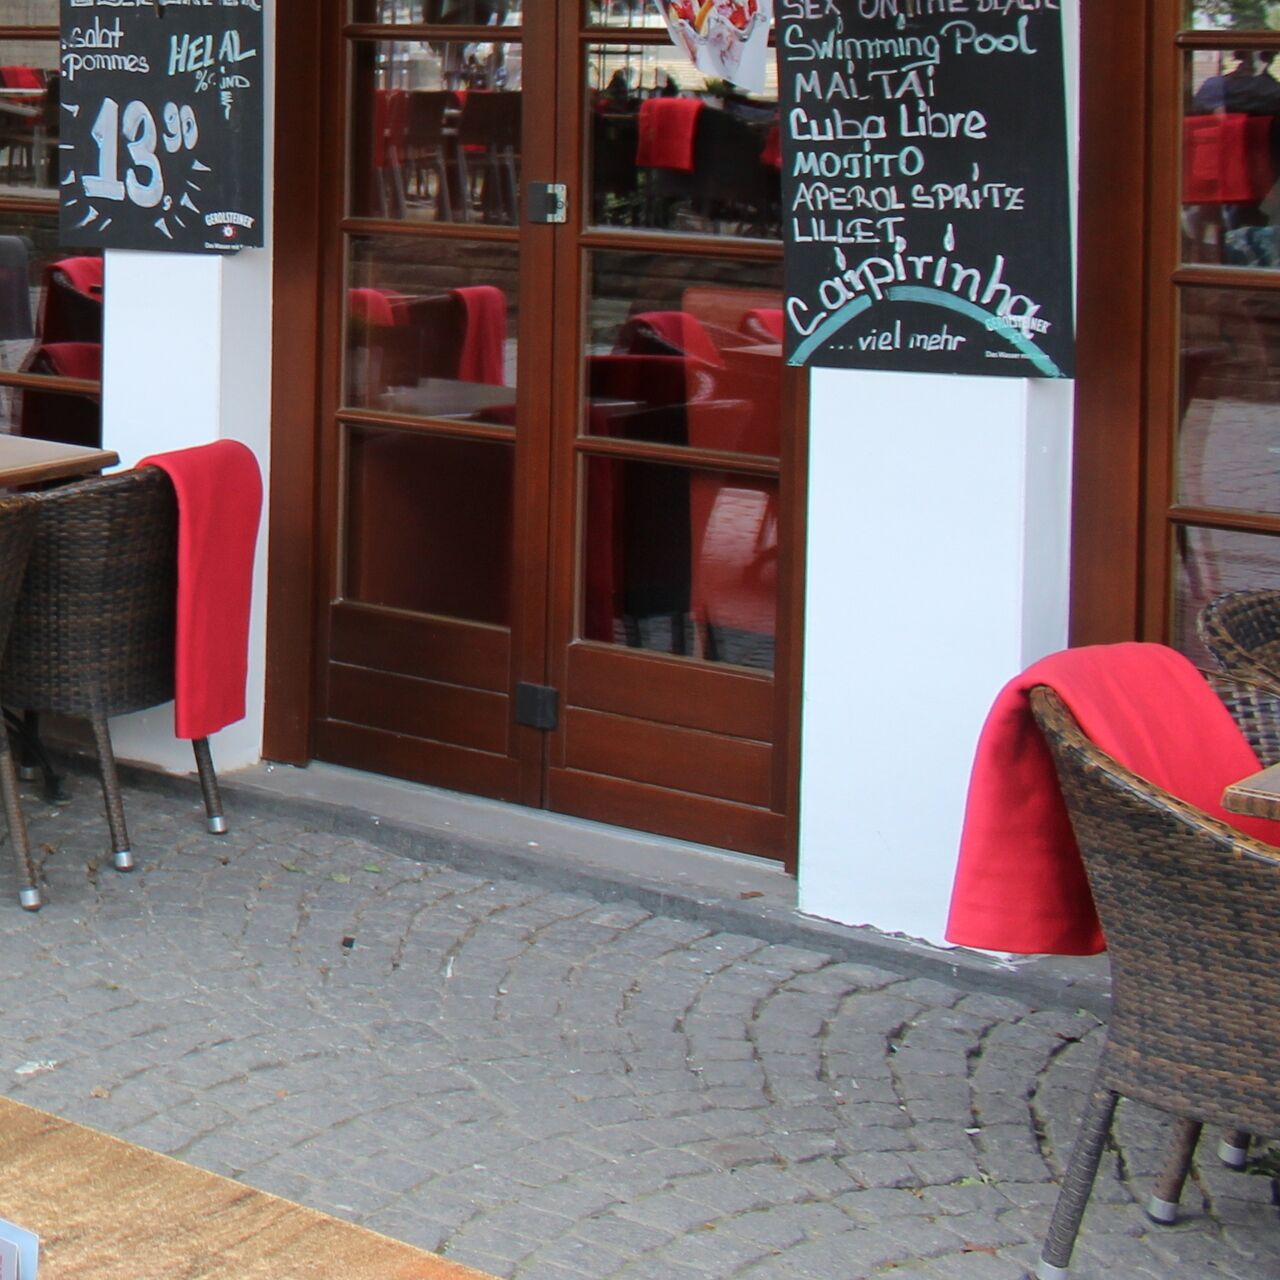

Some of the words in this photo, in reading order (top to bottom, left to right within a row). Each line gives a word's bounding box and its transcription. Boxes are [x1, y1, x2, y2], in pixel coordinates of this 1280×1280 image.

[784, 15, 941, 71] Swimming
[940, 15, 1038, 56] Pool
[790, 108, 888, 141] Cuba
[900, 99, 988, 140] Libre
[792, 181, 906, 212] APEROL
[204, 211, 256, 229] GEROLSTEINER
[792, 216, 905, 244] LILLET
[909, 324, 967, 352] mehr
